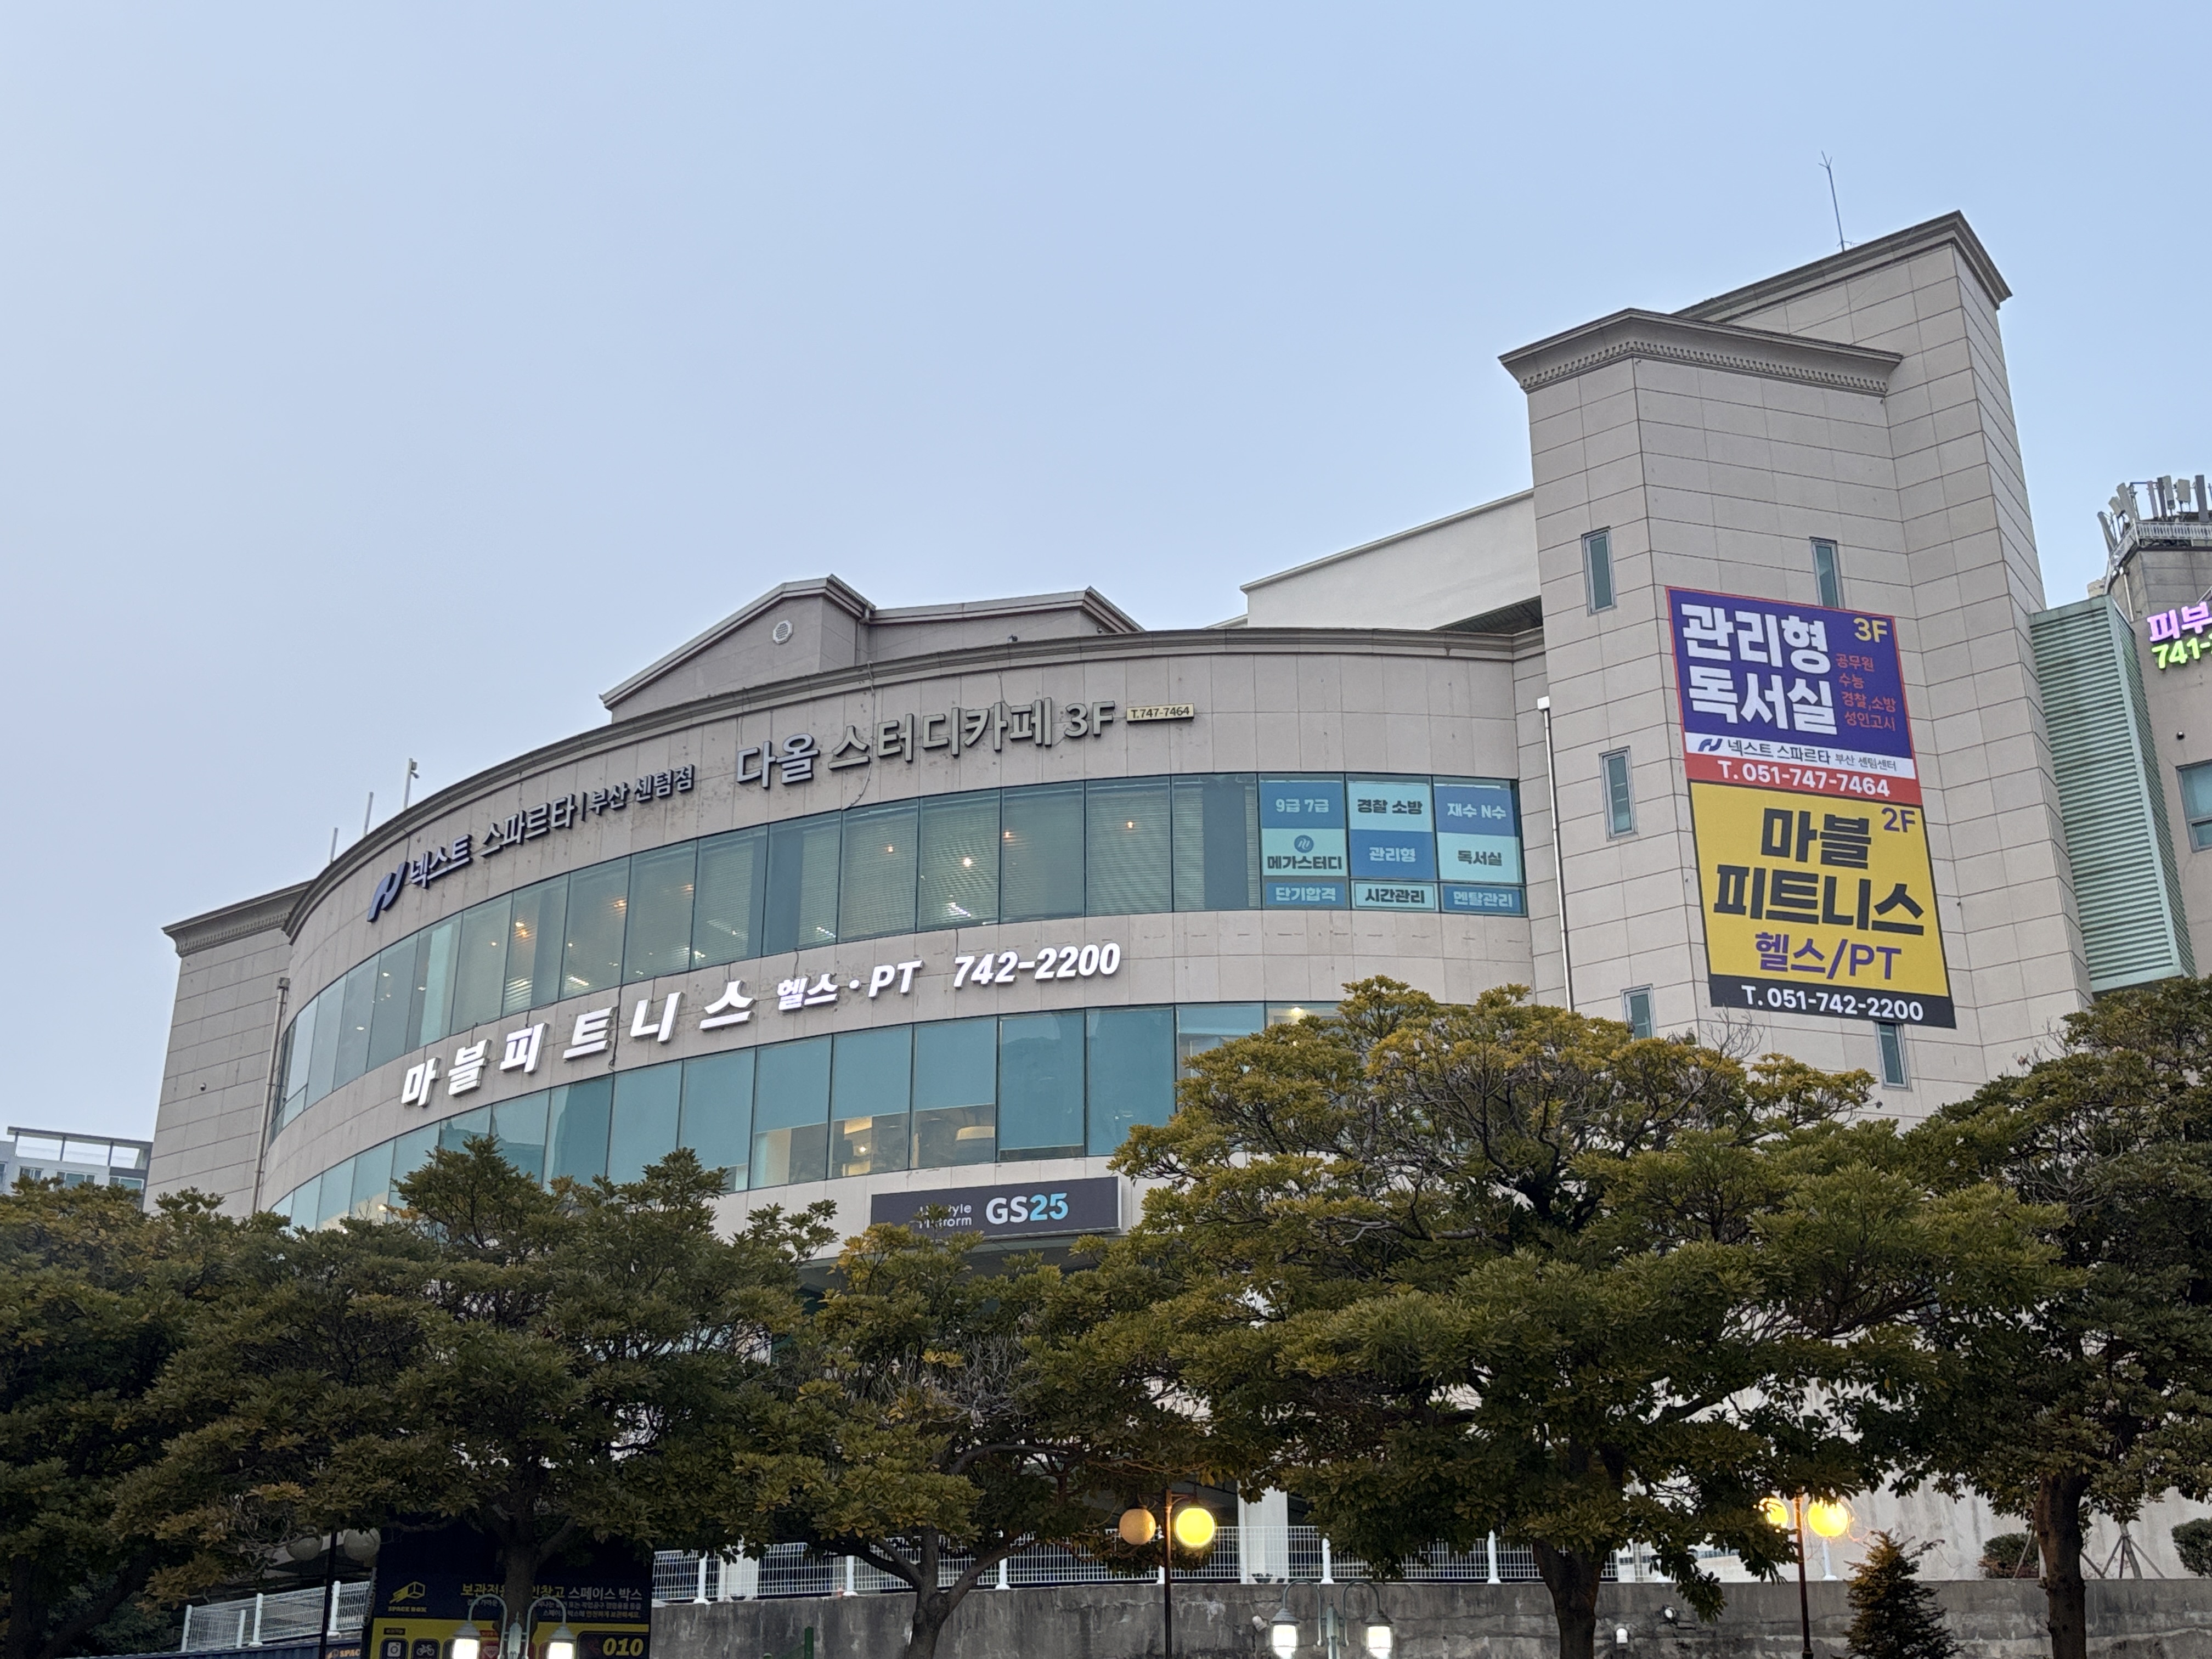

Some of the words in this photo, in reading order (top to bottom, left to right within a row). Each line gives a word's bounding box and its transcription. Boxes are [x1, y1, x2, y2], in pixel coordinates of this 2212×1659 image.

[1853, 618, 1888, 643] 3F
[2147, 602, 2212, 642] 피부
[1681, 603, 1831, 674] 관리형
[2152, 633, 2212, 669] 741-
[1836, 653, 1874, 672] 공무원
[1839, 673, 1864, 689] 수능
[1131, 706, 1190, 719] T.747-7464
[1689, 665, 1837, 735] 독서실
[1844, 712, 1895, 731] 성인고시
[737, 733, 819, 788] 다올
[828, 697, 1052, 769] 스터디카페
[1064, 701, 1115, 737] 3F
[1728, 740, 1774, 757] 넥스트
[1777, 746, 1831, 764] 스파르타
[1835, 754, 1855, 766] 부산
[1858, 757, 1897, 771] 센텀센터
[1742, 763, 1891, 797] 051-747-7464
[1276, 799, 1300, 813] 9급
[1304, 799, 1329, 813] 7급
[1357, 799, 1388, 814] 경찰
[1392, 800, 1423, 815] 소방
[1447, 803, 1477, 818] 재수
[1481, 805, 1506, 820] N수
[410, 834, 471, 889] 넥스트
[480, 794, 575, 857] 스파르타
[589, 782, 630, 815] 부산
[634, 764, 695, 802] 센텀점
[1881, 808, 1915, 833] 2F
[1760, 808, 1871, 870] 마블
[1267, 856, 1342, 870] 메가스터디
[1369, 847, 1416, 862] 관리형
[1458, 850, 1502, 866] 독서실
[1276, 888, 1336, 901] 단기합격
[1365, 888, 1425, 904] 시간관리
[1454, 891, 1513, 907] 멘탈관리
[1714, 864, 1924, 936] 피트니스
[953, 943, 1120, 988] 742-2200
[1755, 932, 1901, 980] 헬스/PT
[1767, 988, 1923, 1021] 051-742-2200
[986, 1193, 1069, 1224] GS25
[568, 1587, 616, 1601] 스페이스
[619, 1587, 642, 1601] 박스
[603, 1637, 644, 1657] 010
